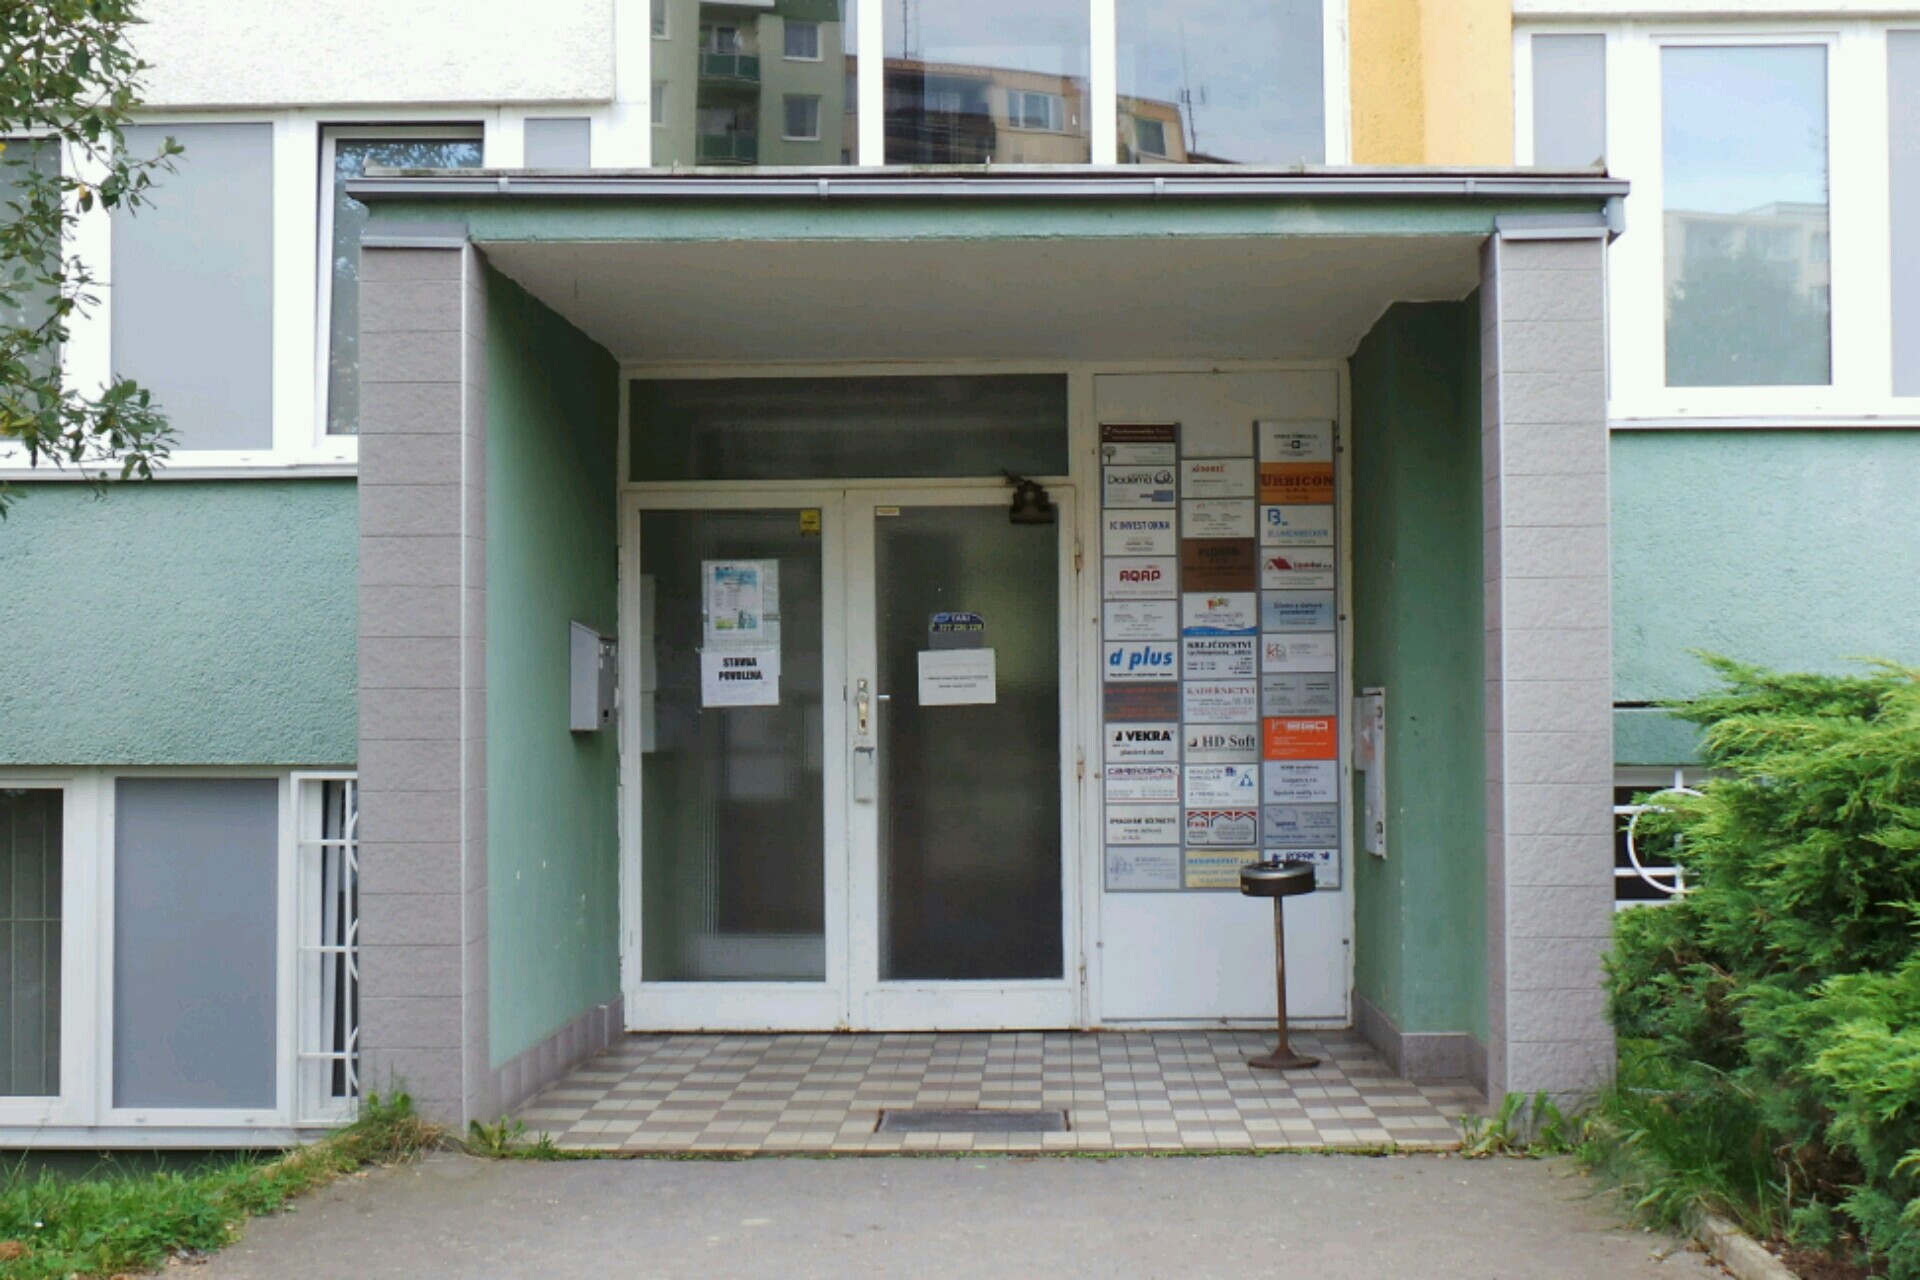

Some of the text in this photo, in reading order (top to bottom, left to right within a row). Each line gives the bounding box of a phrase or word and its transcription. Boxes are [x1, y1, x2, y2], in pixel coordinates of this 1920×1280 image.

[1260, 473, 1334, 487] URBICON
[1119, 521, 1147, 530] INVEST
[1119, 570, 1161, 582] AQAP
[723, 657, 757, 668] STAVBA
[1109, 647, 1123, 666] d
[1128, 645, 1173, 671] plus
[718, 670, 763, 681] POVOLENA
[1125, 730, 1171, 741] VEKRA
[1202, 734, 1256, 748] HD Soft
